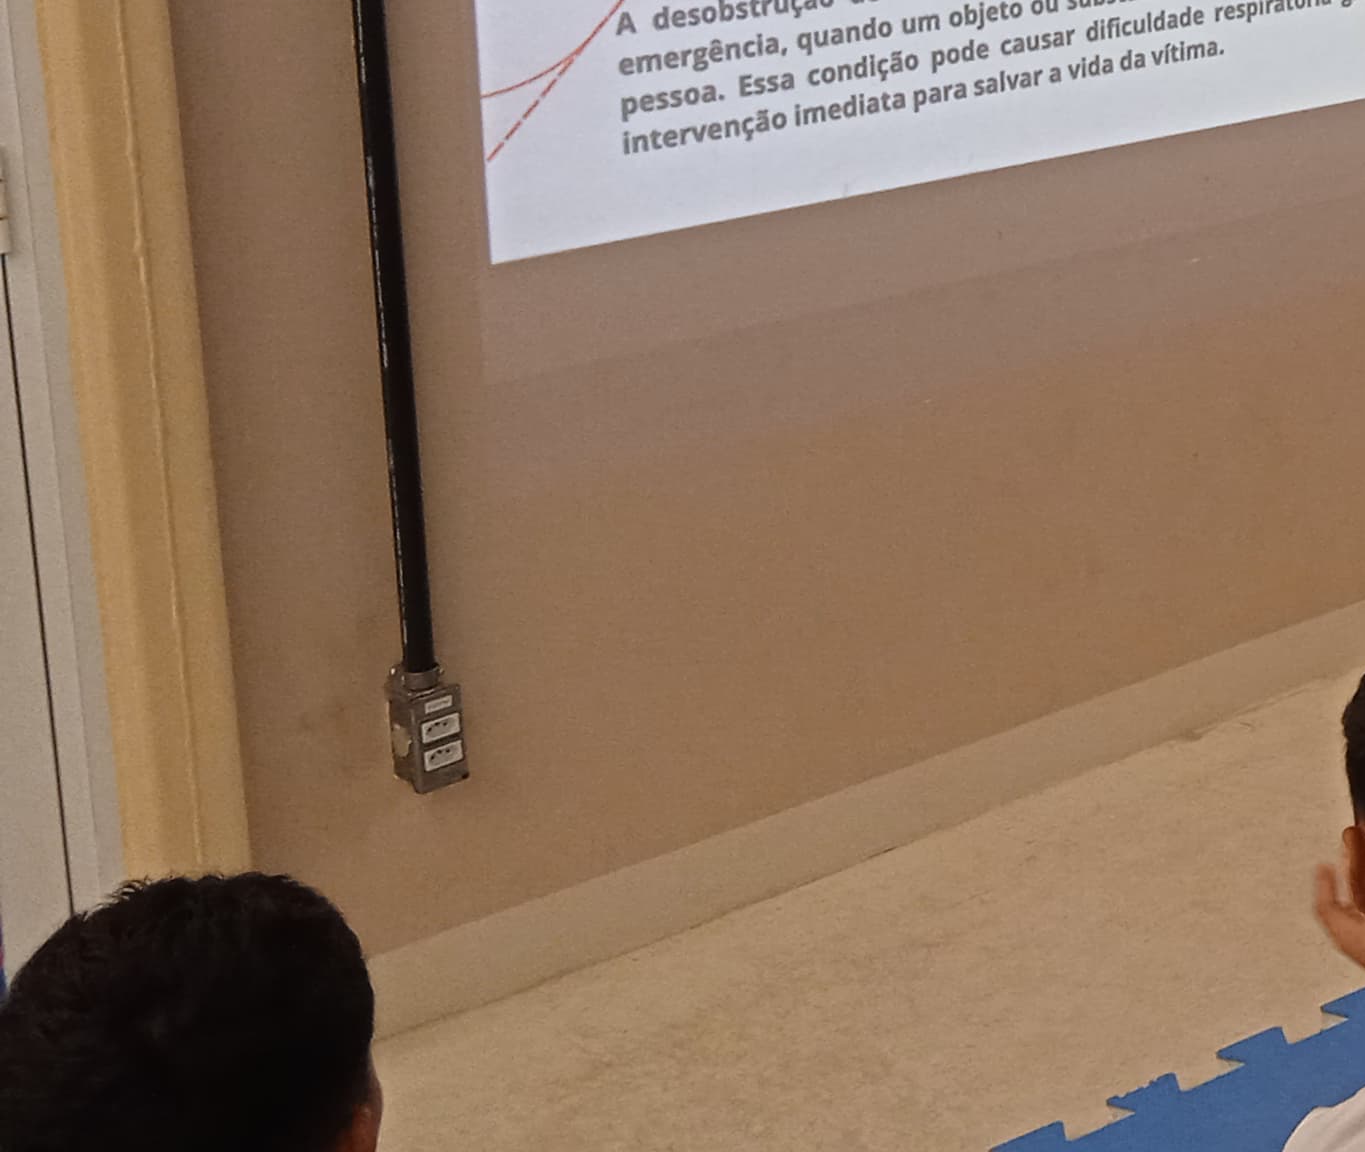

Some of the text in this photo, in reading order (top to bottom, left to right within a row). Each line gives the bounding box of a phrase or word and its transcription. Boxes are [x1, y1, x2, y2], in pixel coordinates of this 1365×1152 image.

[615, 11, 638, 36] A
[618, 33, 789, 76] emergência,
[796, 16, 893, 57] quando
[901, 12, 941, 35] um
[948, 1, 1023, 30] objeto
[620, 83, 726, 122] pessoa.
[738, 71, 796, 98] Essa
[806, 50, 919, 86] condição
[930, 38, 990, 74] pode
[999, 26, 1076, 56] causar
[1085, 5, 1206, 43] dificuldade
[622, 40, 1226, 156] intervenção imediata para salvar a vida da vítima.
